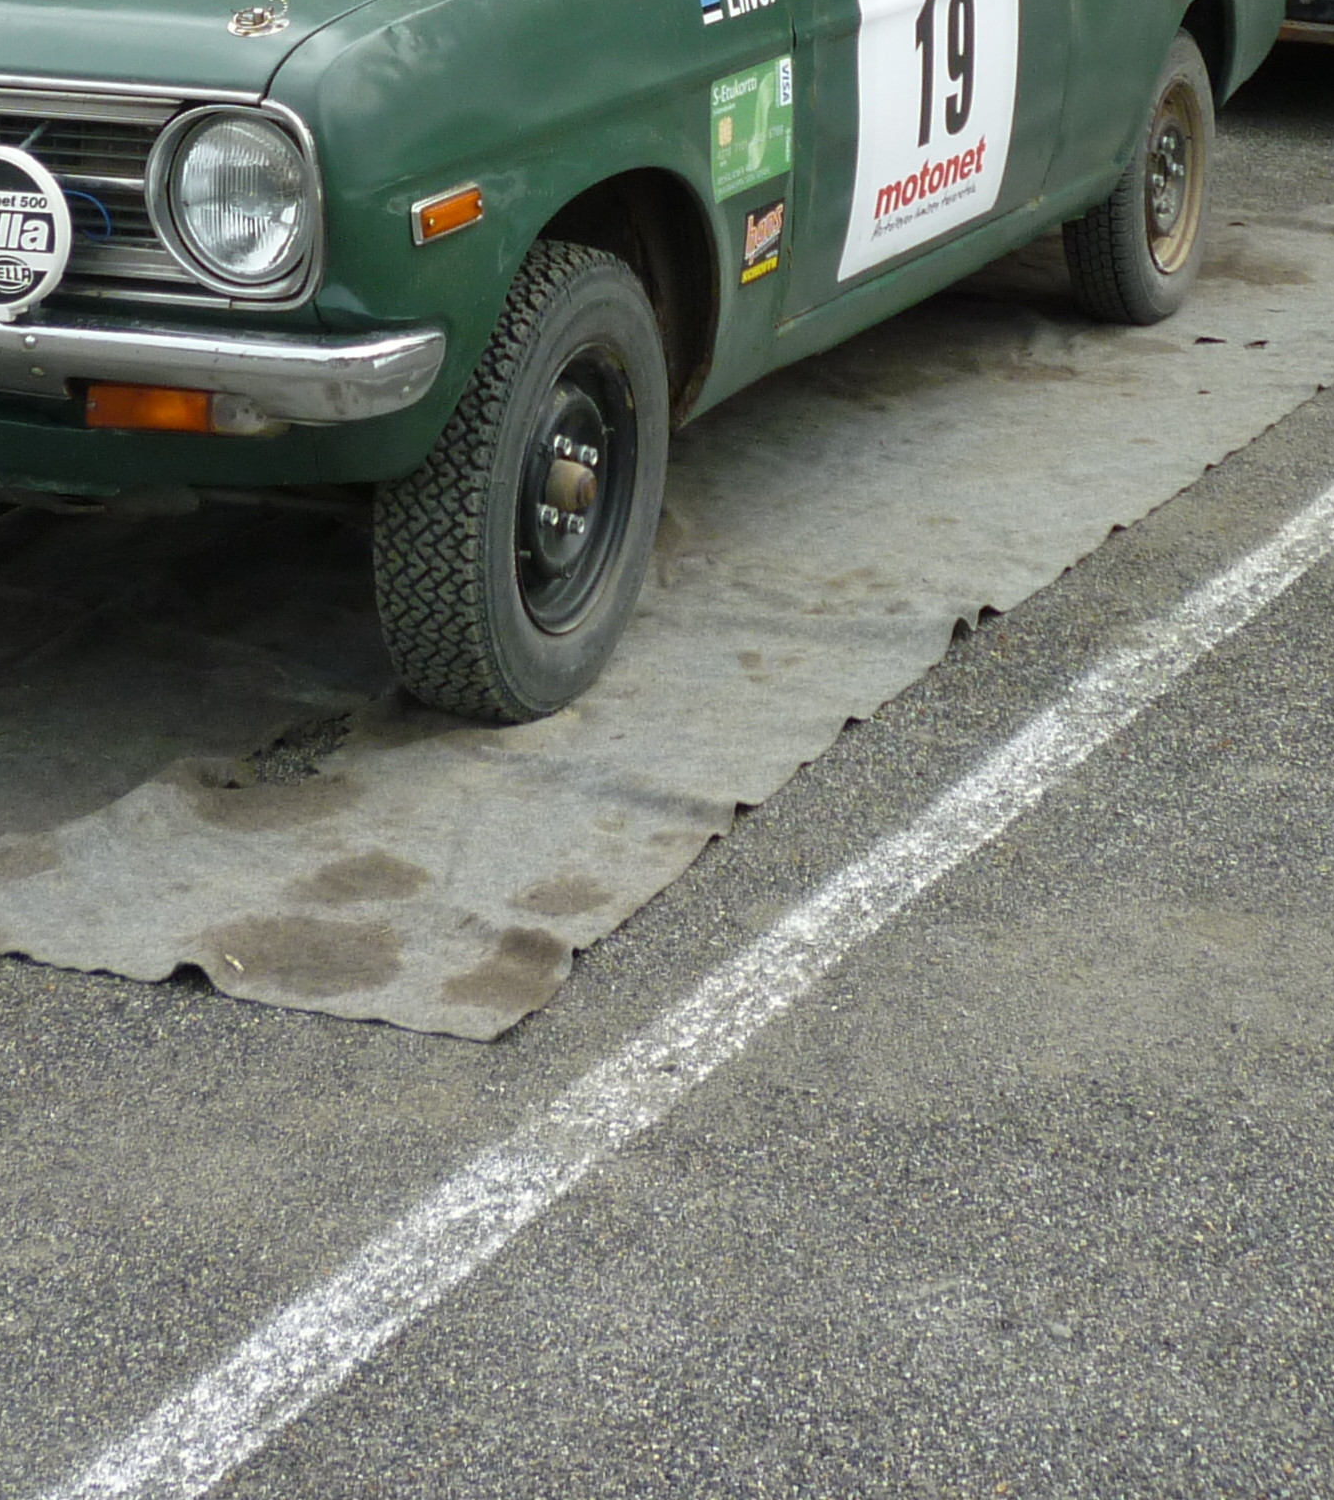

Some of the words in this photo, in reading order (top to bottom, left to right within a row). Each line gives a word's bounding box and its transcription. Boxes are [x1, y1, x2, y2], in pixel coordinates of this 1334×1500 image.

[781, 63, 791, 103] VISA
[874, 134, 986, 220] motonet
[19, 196, 47, 209] 500
